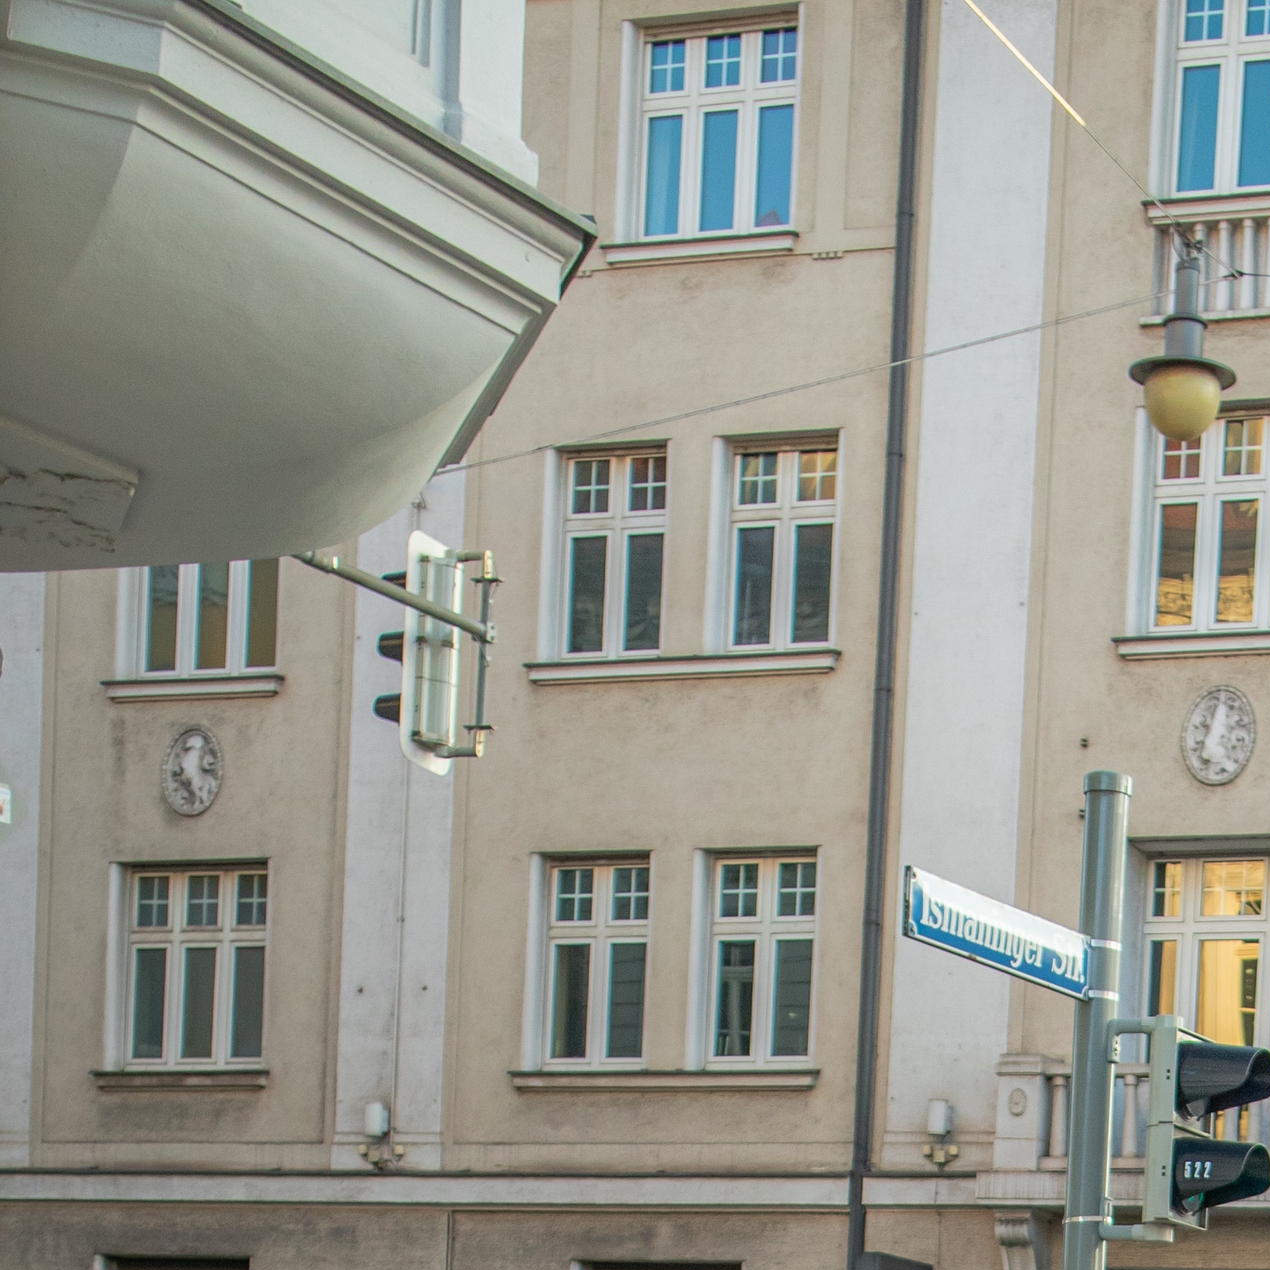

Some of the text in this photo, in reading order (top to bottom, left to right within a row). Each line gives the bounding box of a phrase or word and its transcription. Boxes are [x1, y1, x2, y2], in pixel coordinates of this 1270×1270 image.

[920, 880, 1086, 984] Ismaninger Str.
[1183, 1161, 1213, 1179] 522
